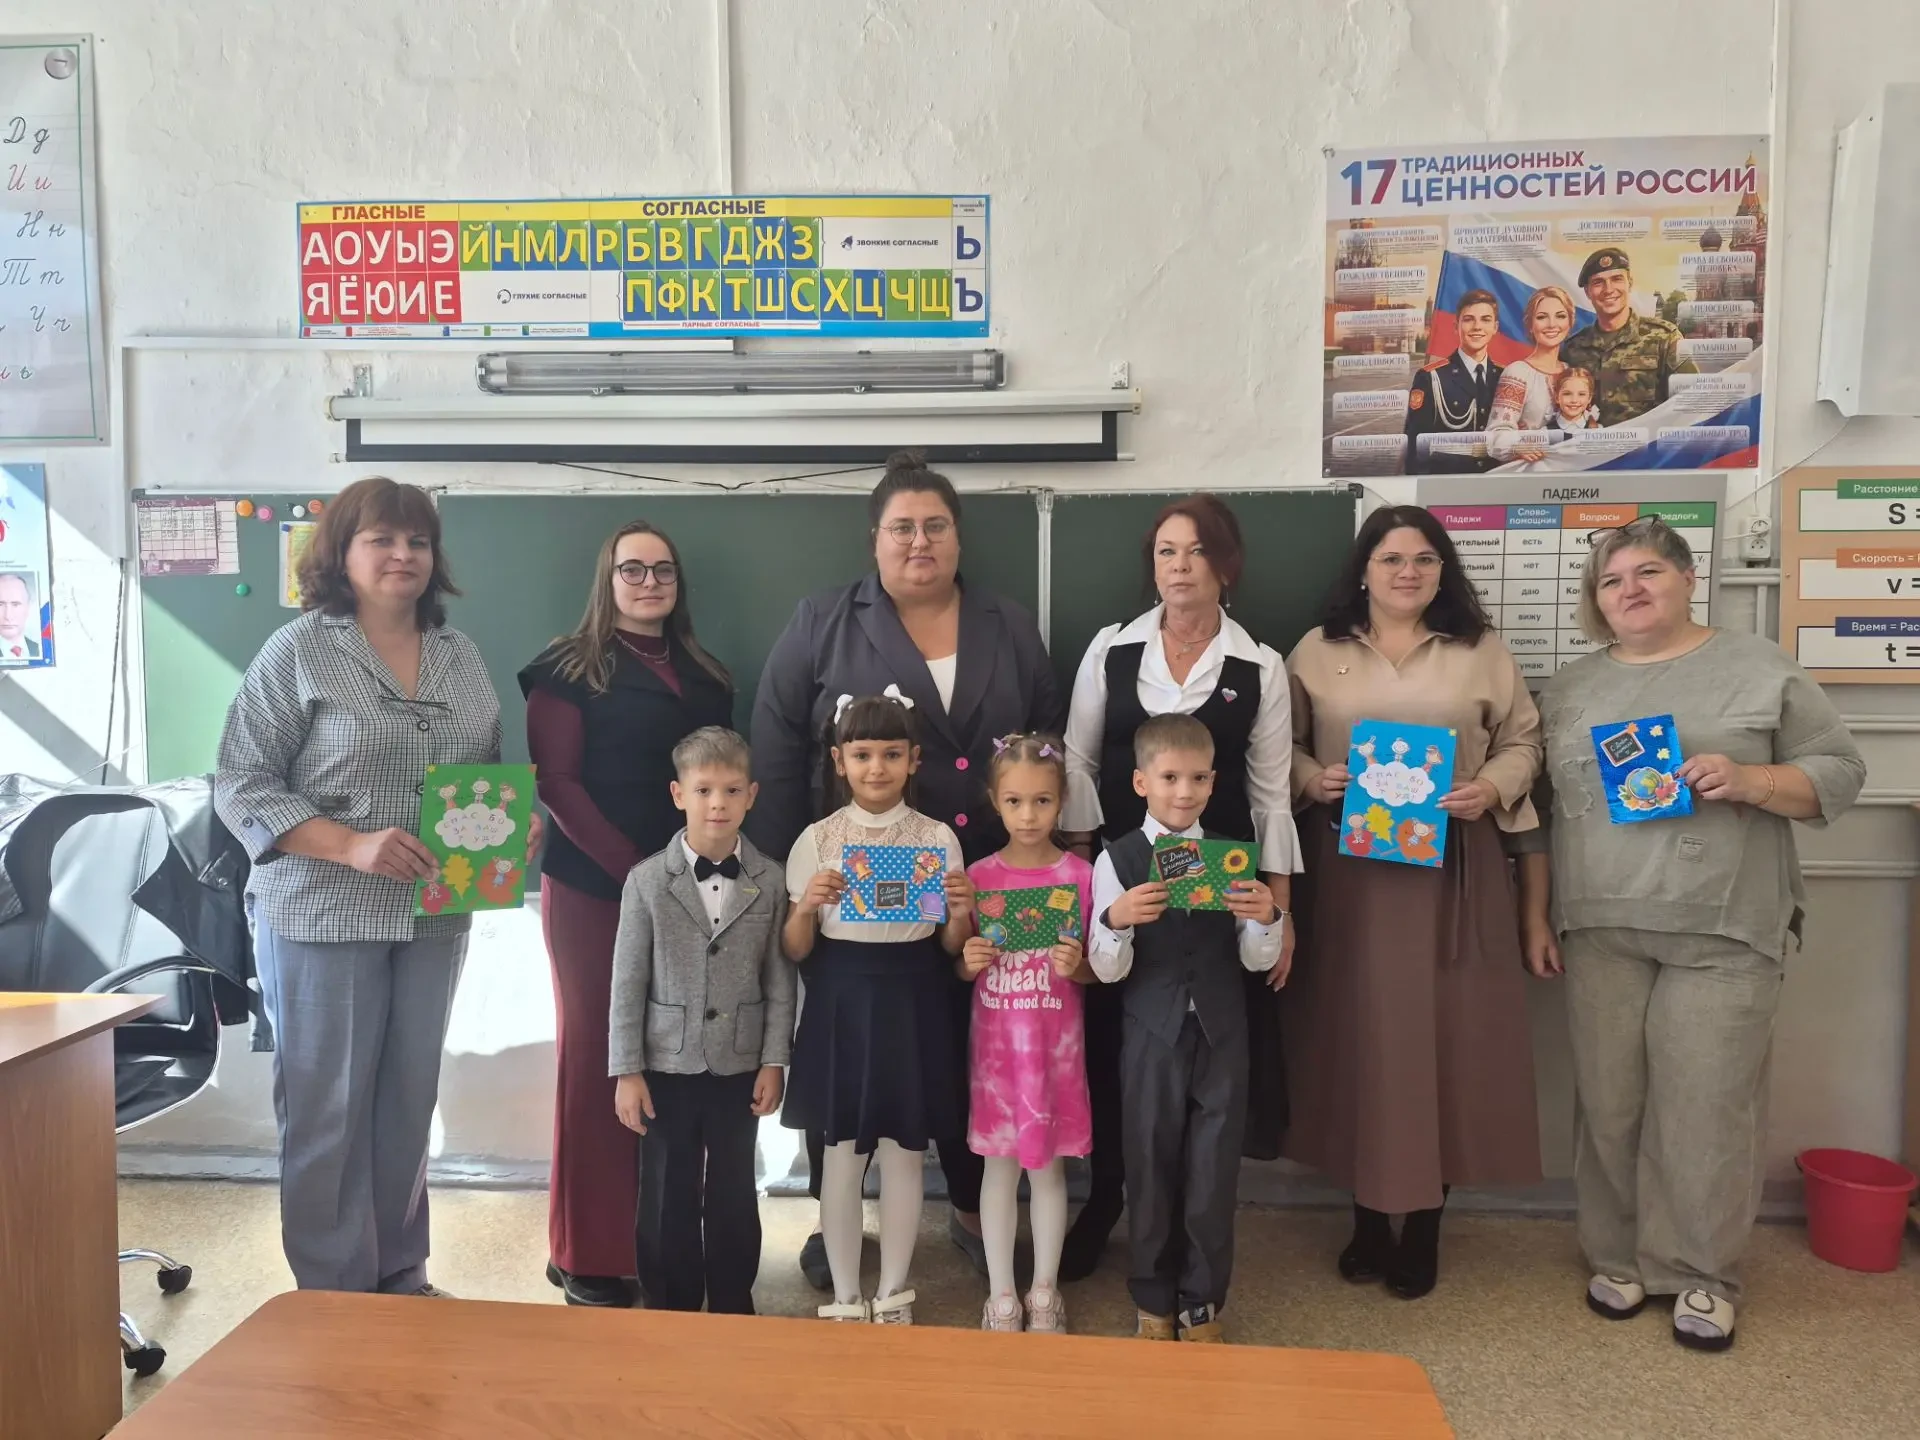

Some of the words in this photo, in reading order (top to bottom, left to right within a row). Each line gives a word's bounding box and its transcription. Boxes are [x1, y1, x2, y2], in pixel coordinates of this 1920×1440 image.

[1402, 150, 1585, 176] ТРАДИЦИОННЫХ
[1340, 159, 1398, 205] 17
[1402, 165, 1606, 206] ЦЕННОСТЕЙ
[1616, 167, 1757, 196] РОССИИ
[332, 205, 425, 220] ГЛАСНЫЕ
[642, 200, 766, 217] СОГЛАСНЫЕ
[956, 225, 982, 260] Ь
[954, 277, 983, 313] Ъ
[1542, 487, 1600, 500] ПАДЕЖИ
[1853, 484, 1918, 494] Расстояние
[1517, 507, 1551, 517] Слово-
[1579, 513, 1620, 522] Вопросы
[1888, 502, 1906, 525] S
[1445, 514, 1482, 524] Падежи
[1509, 517, 1557, 526] помощник
[1452, 537, 1500, 547] ительный
[1521, 538, 1543, 546] есть
[1852, 553, 1905, 565] Скорость
[1521, 588, 1540, 596] даю
[1517, 613, 1542, 622] вижу
[1851, 621, 1887, 633] Время
[1510, 638, 1548, 646] горжусь
[1885, 643, 1897, 663] t
[1519, 662, 1544, 671] умаю
[986, 961, 1051, 994] ahead
